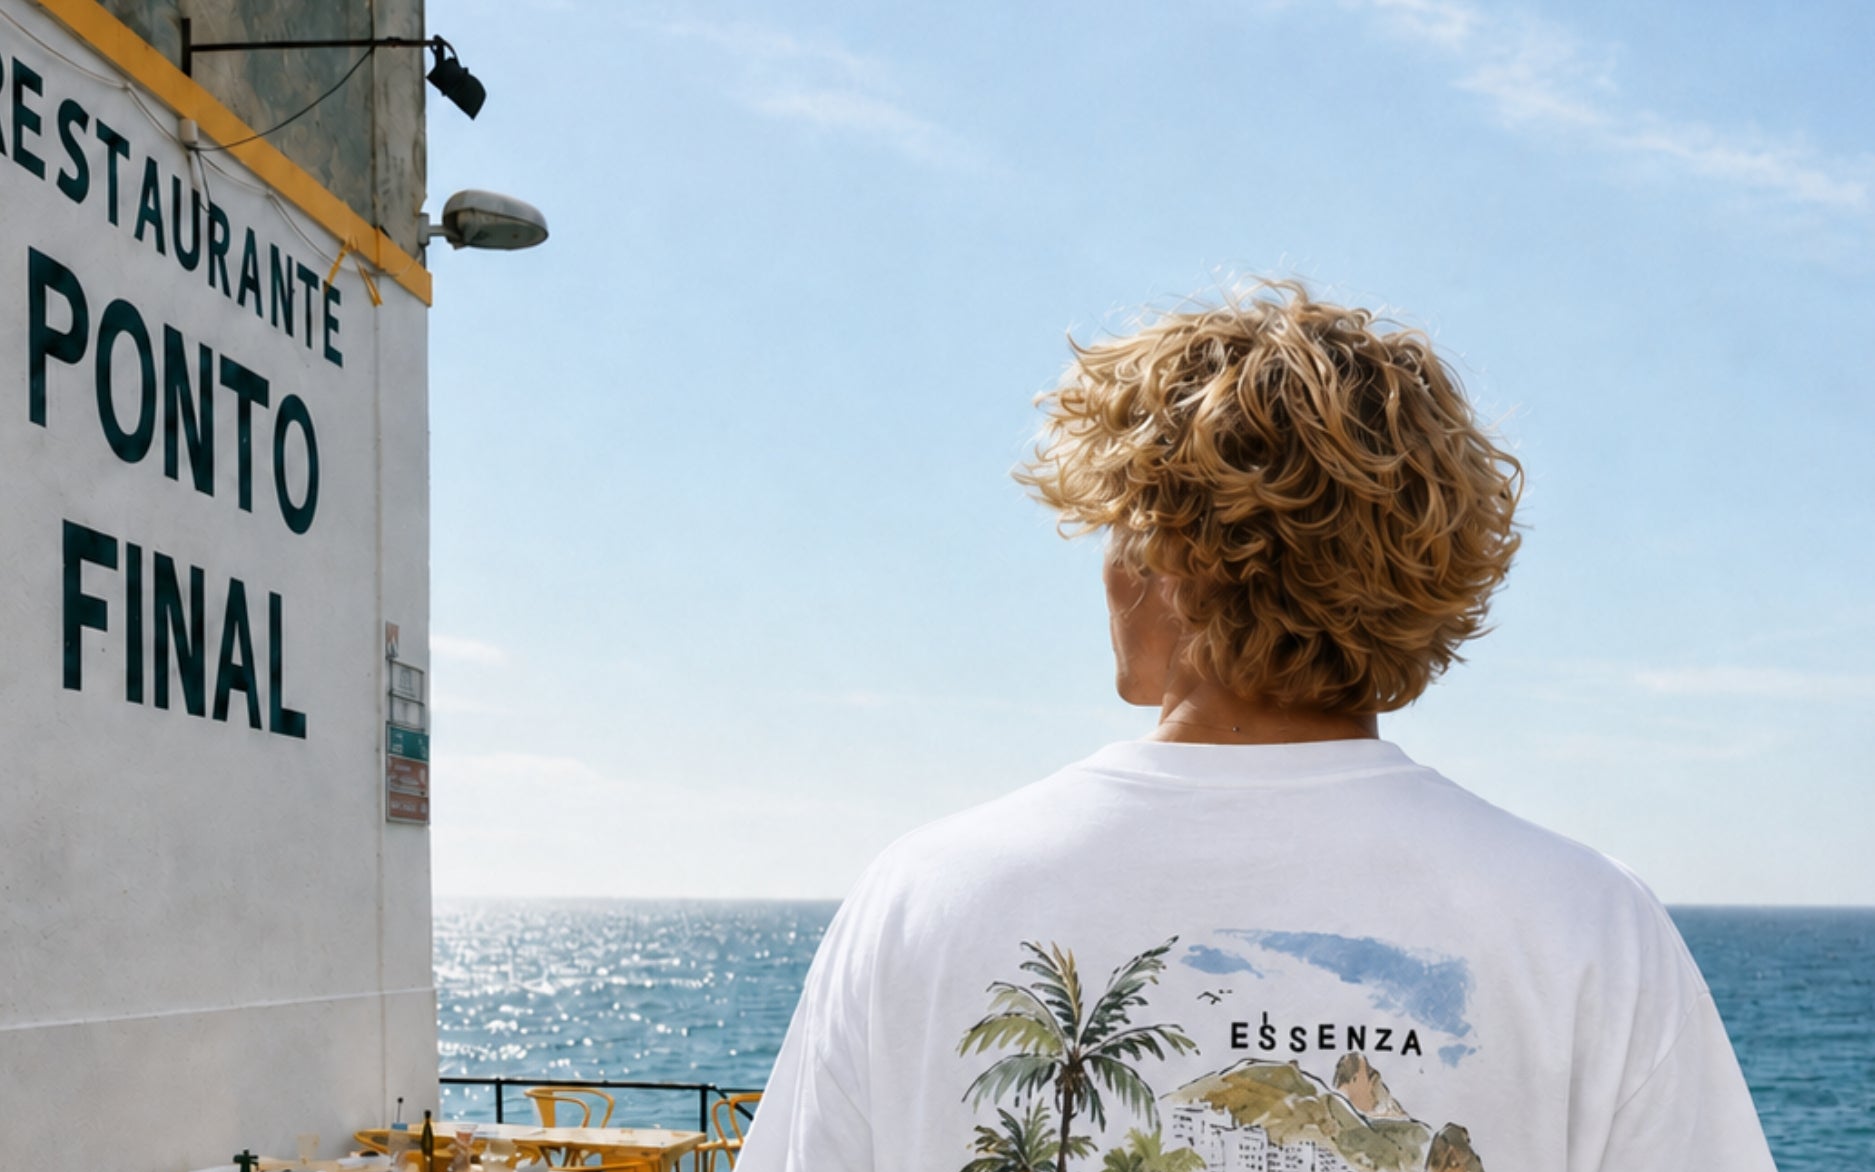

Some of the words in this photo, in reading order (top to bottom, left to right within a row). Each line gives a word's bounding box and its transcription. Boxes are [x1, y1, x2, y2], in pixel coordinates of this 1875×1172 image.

[0, 50, 344, 368] ESTAURANTE
[28, 246, 320, 535] PONTO
[62, 519, 307, 740] FINAL
[1230, 1021, 1422, 1057] ESSENZA
